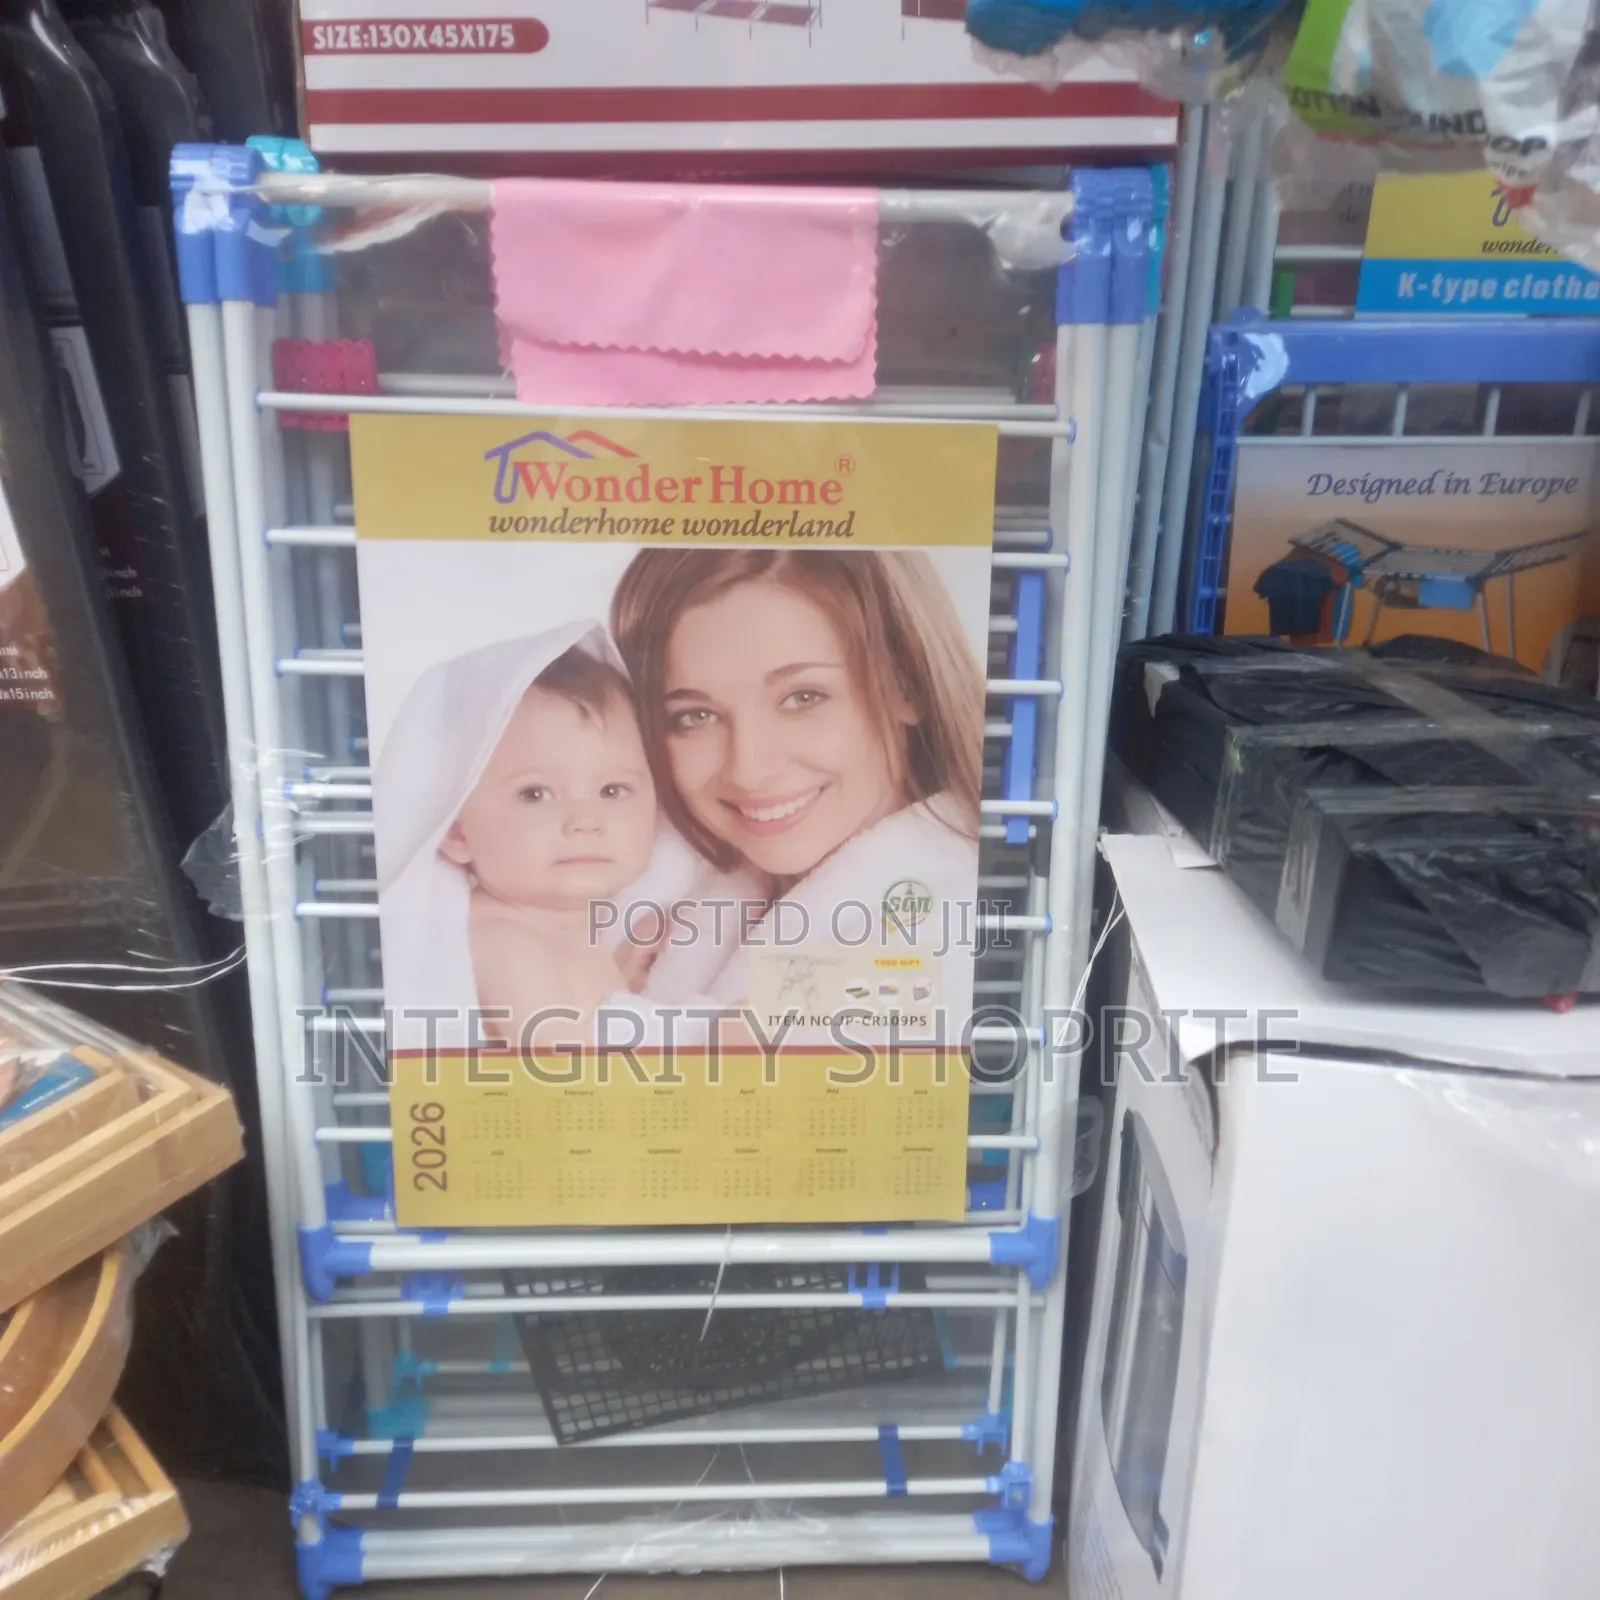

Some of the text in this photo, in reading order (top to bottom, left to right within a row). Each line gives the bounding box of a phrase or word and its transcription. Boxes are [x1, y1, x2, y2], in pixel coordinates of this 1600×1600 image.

[313, 24, 515, 49] SIZE:130X45X175
[1398, 271, 1497, 303] K-type
[1306, 469, 1580, 503] Designed in Europe
[489, 507, 856, 539] wonderhome wonderland
[768, 1015, 805, 1027] ITEM
[409, 1101, 448, 1193] 2026
